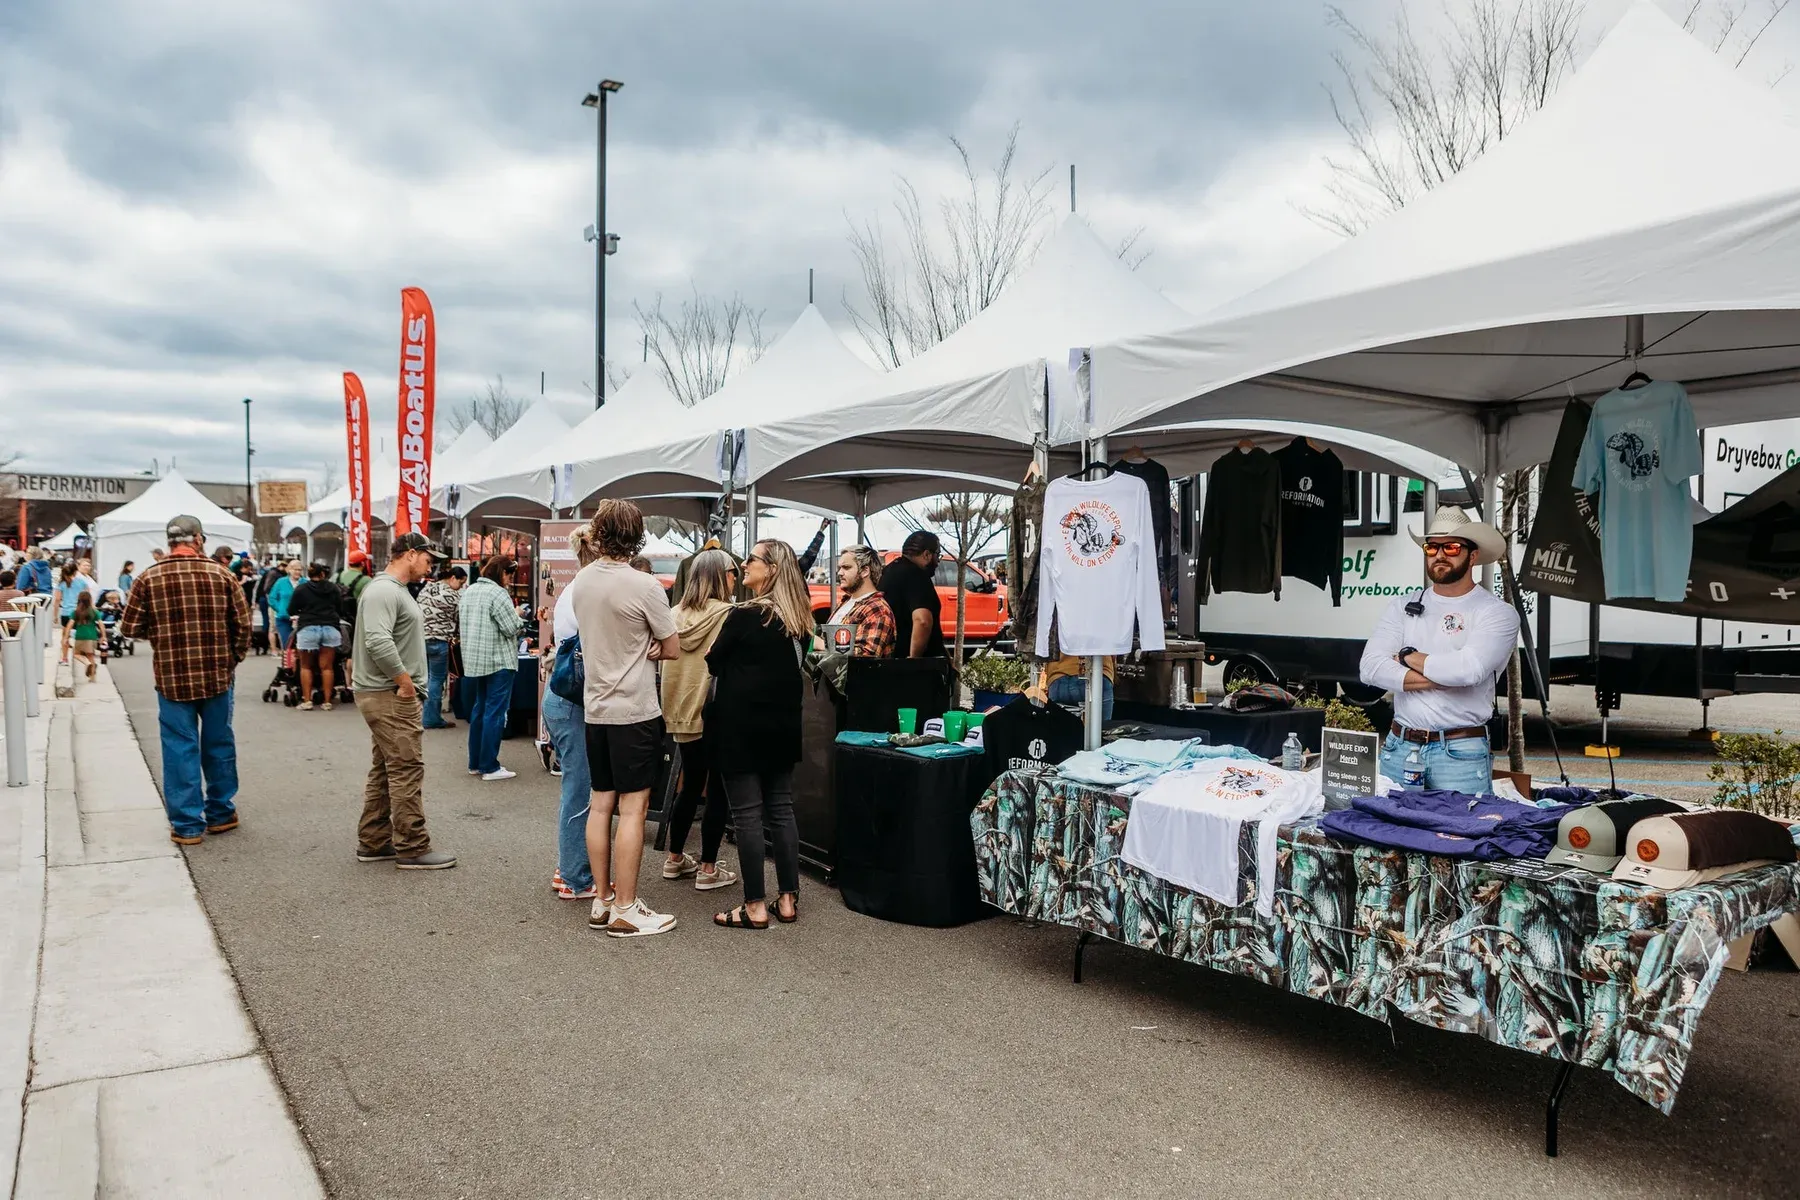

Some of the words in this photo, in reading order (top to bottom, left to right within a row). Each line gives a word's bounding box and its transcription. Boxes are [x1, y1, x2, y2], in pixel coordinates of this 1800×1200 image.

[1716, 437, 1782, 473] Dryvebox
[18, 474, 126, 494] REFORMATION
[1574, 490, 1592, 517] THE
[1342, 549, 1376, 580] olf
[1532, 548, 1578, 574] MILL
[1537, 571, 1575, 585] ETOWAH
[1329, 742, 1353, 751] WILDLIFE
[1354, 745, 1368, 753] EXPO
[1327, 770, 1340, 779] Long
[1341, 773, 1357, 781] sleeve
[1361, 775, 1371, 783] $25
[1327, 780, 1341, 788] Short
